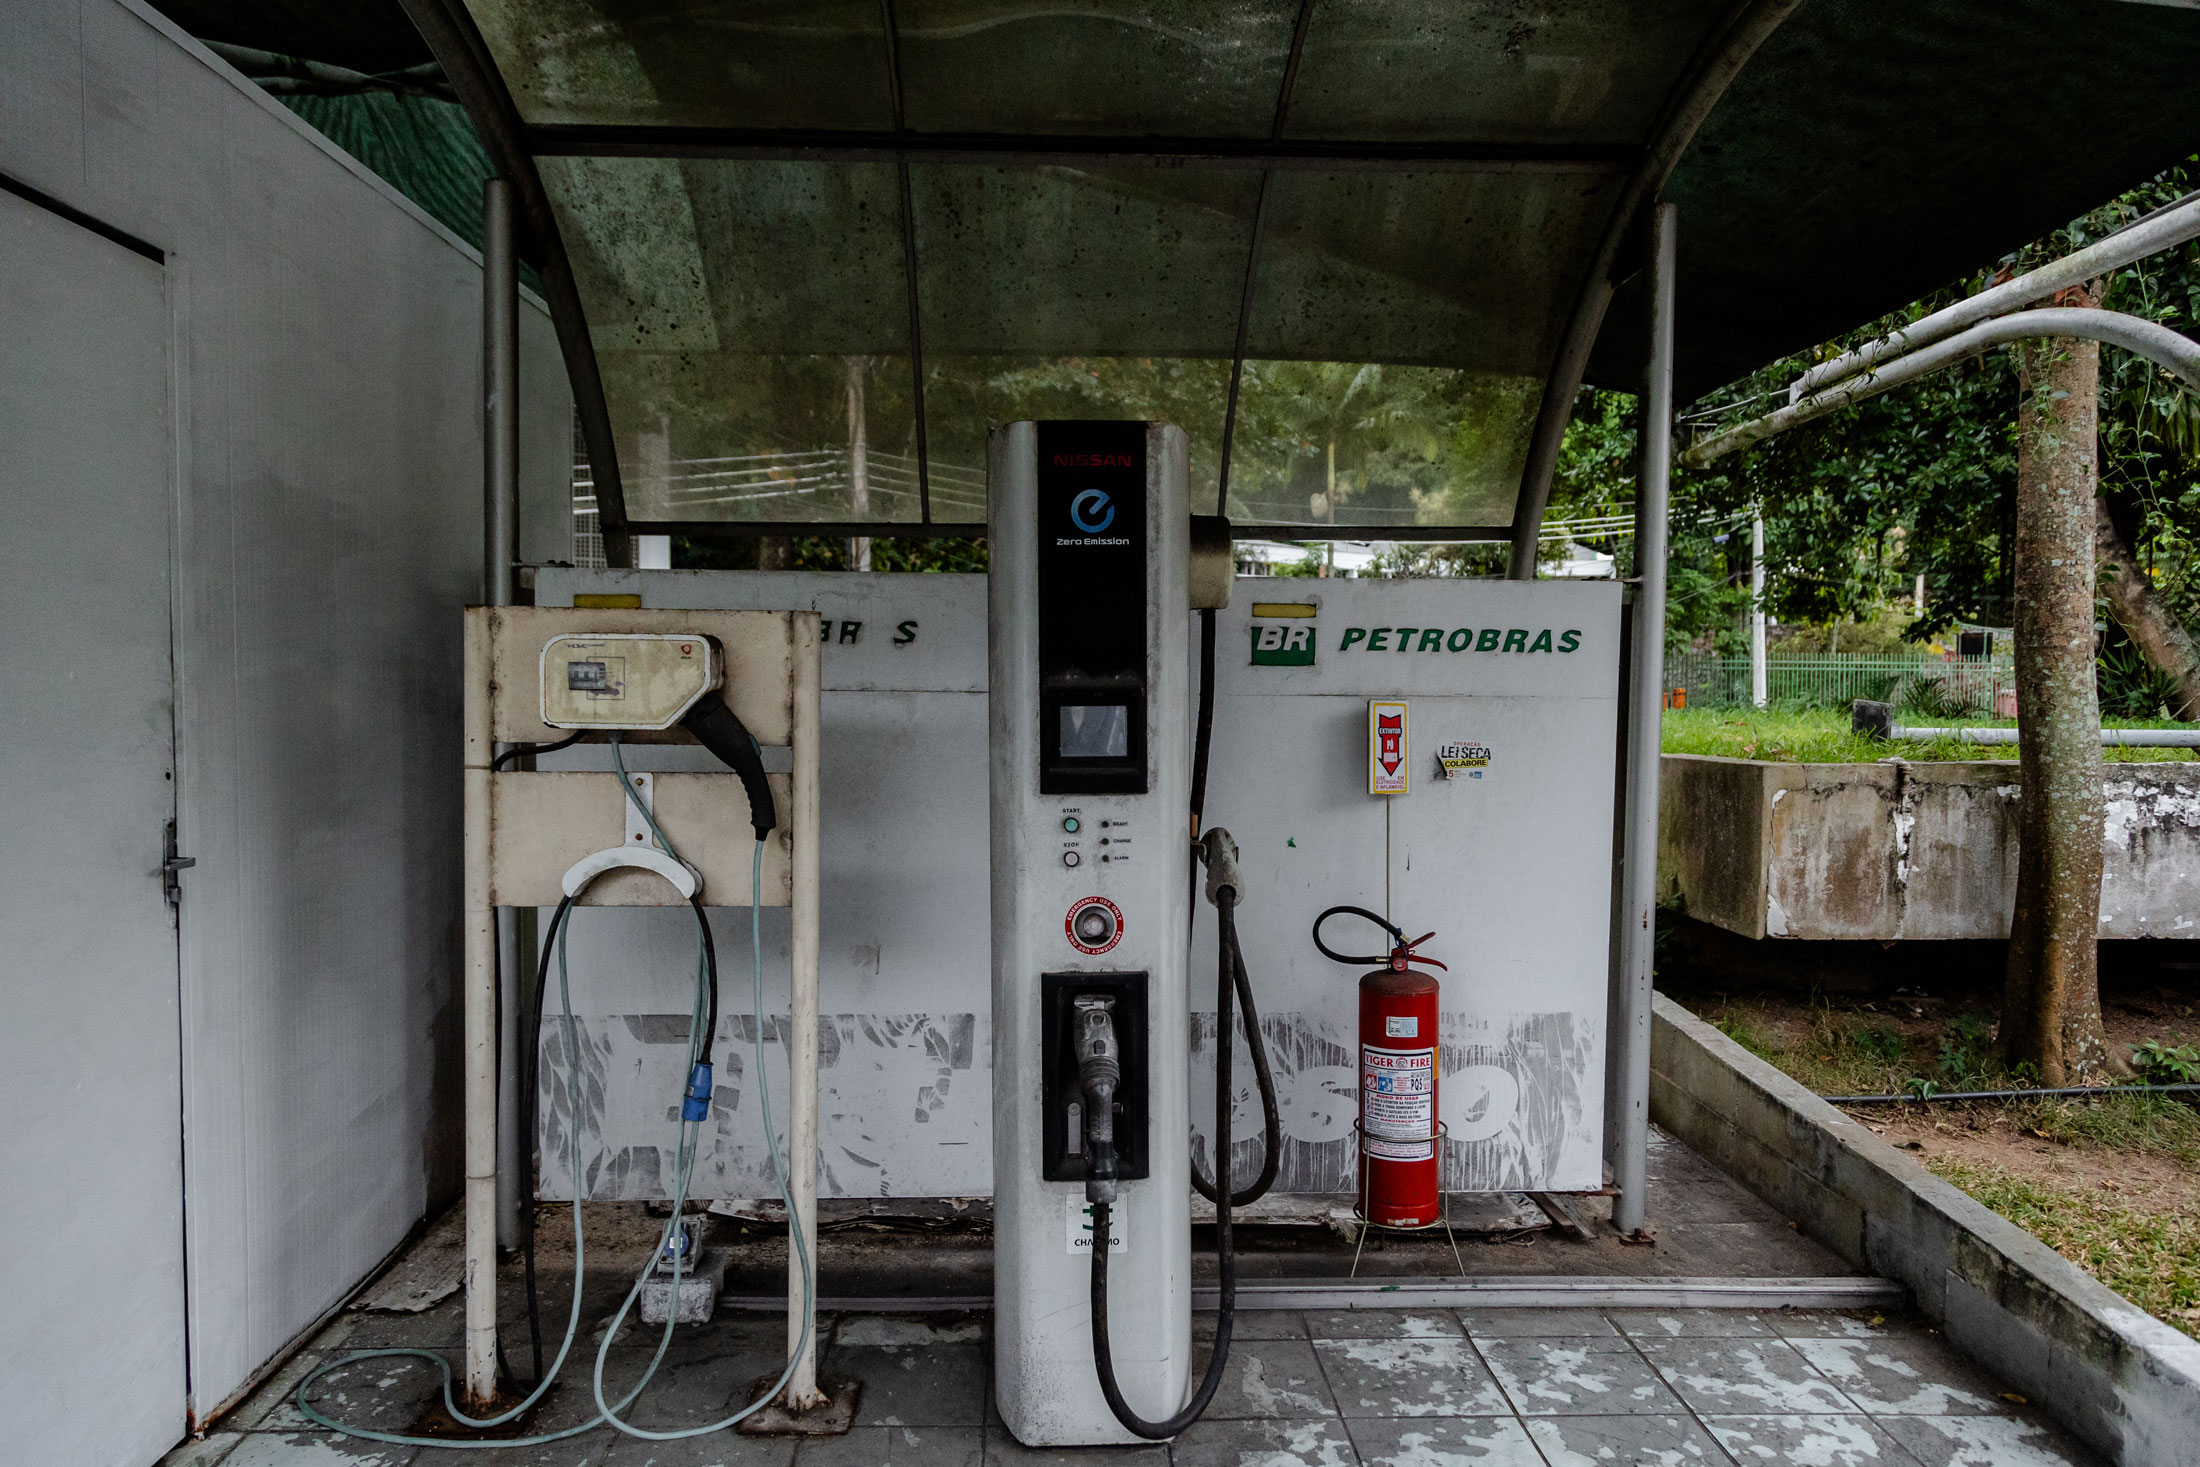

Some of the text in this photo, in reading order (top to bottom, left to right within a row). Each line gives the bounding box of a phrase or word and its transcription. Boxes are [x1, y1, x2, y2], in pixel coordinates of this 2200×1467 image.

[1054, 454, 1132, 467] NISSAN
[1084, 537, 1130, 545] Emission
[1256, 625, 1582, 653] BR PETROBRAS
[1379, 727, 1401, 735] EXTINTOR
[1386, 738, 1394, 751] PÓ
[1441, 745, 1491, 760] LEI SECA
[1444, 759, 1487, 768] COLABORE
[1448, 769, 1454, 778] 5
[1067, 897, 1122, 920] EMERGENCY USE ONLY
[1067, 930, 1122, 954] EMERGENCY USE ONLY
[1365, 1053, 1430, 1068] TIGER FIRE
